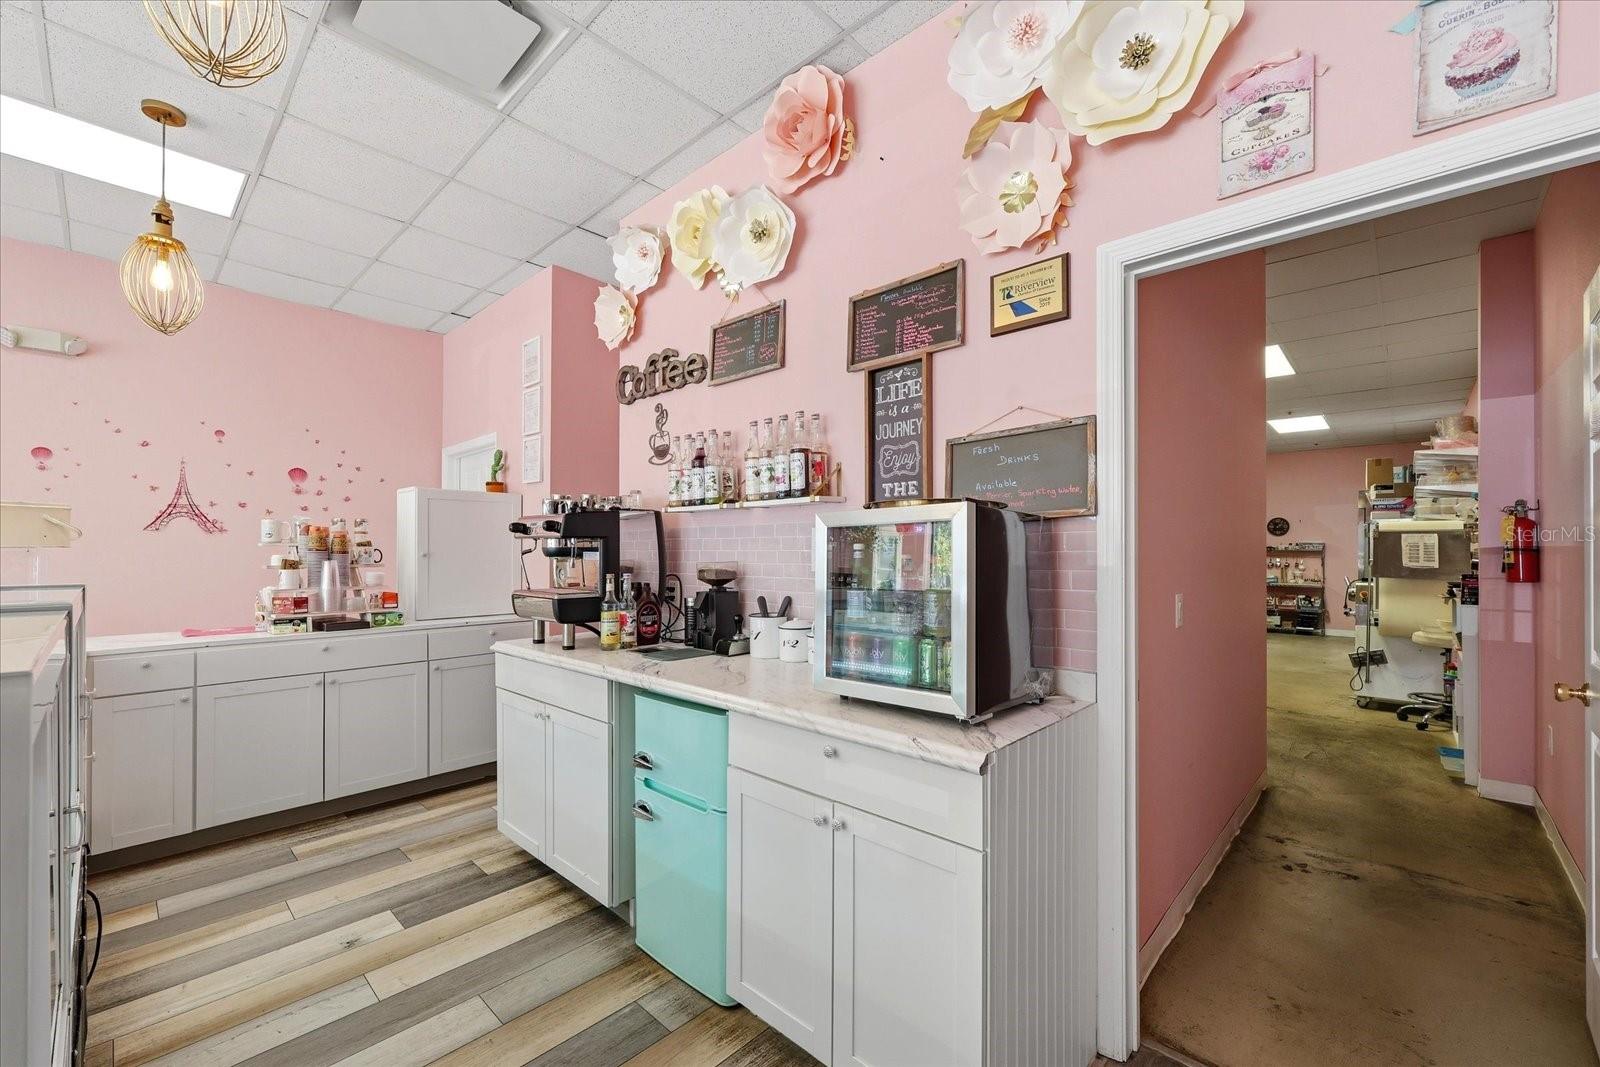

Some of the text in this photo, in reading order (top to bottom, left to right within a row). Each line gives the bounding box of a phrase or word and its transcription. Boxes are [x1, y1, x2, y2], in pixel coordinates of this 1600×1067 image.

[1231, 128, 1300, 155] CUPCAKES
[1014, 277, 1056, 293] Riverview
[616, 348, 708, 405] Coffee
[875, 377, 923, 404] LIFE
[888, 404, 909, 417] is a
[876, 418, 923, 440] JOURNEY
[883, 450, 917, 470] Enjoy
[882, 480, 918, 497] THE
[976, 479, 1018, 491] Available
